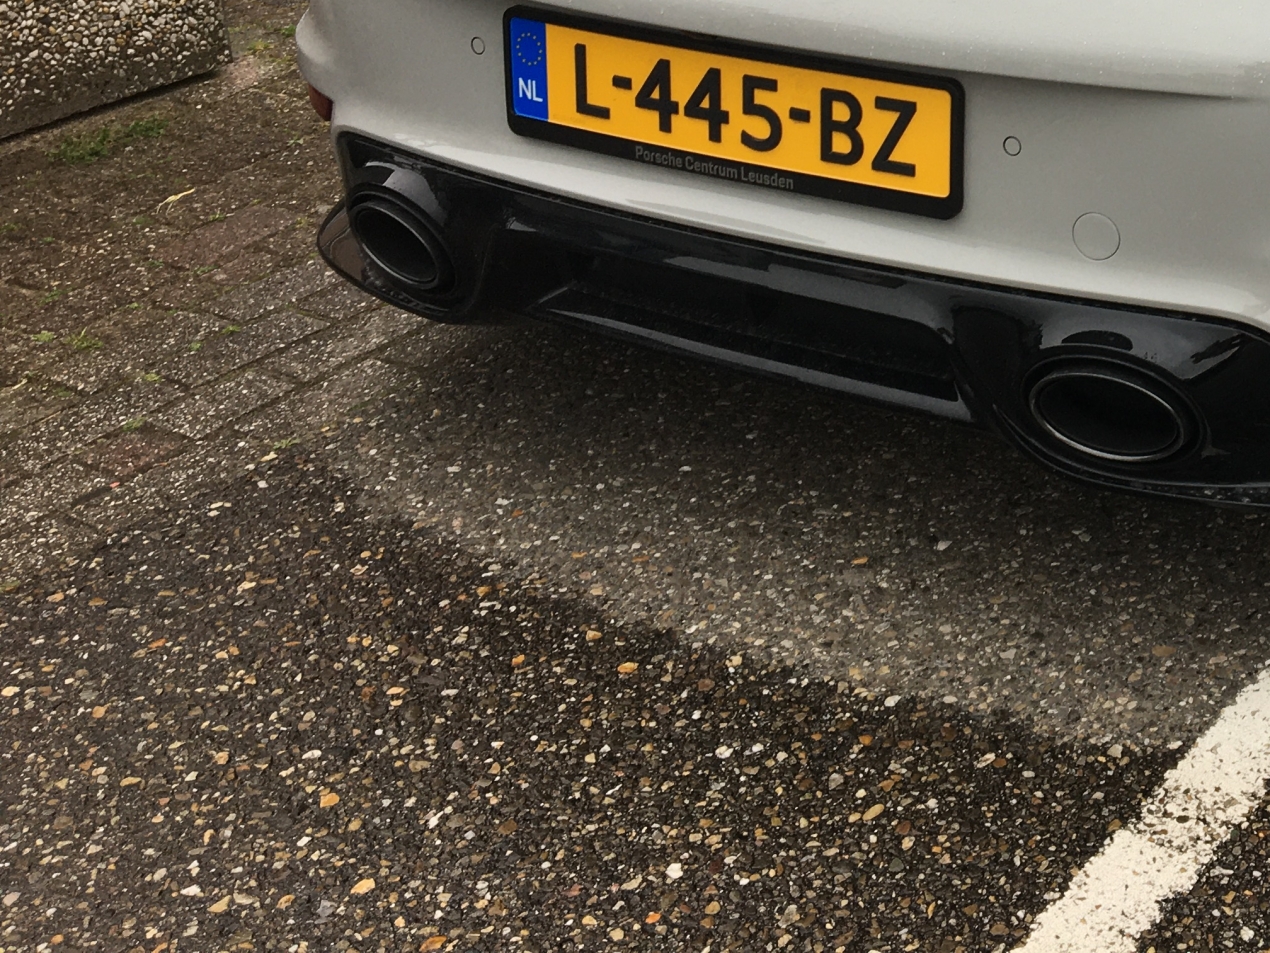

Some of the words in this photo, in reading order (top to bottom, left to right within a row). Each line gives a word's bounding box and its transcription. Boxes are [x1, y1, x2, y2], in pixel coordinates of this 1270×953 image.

[518, 77, 543, 103] NL
[574, 43, 918, 178] L-445-BZ
[635, 145, 683, 168] Porsche
[685, 155, 738, 180] Centrum
[740, 166, 794, 190] Leusden
